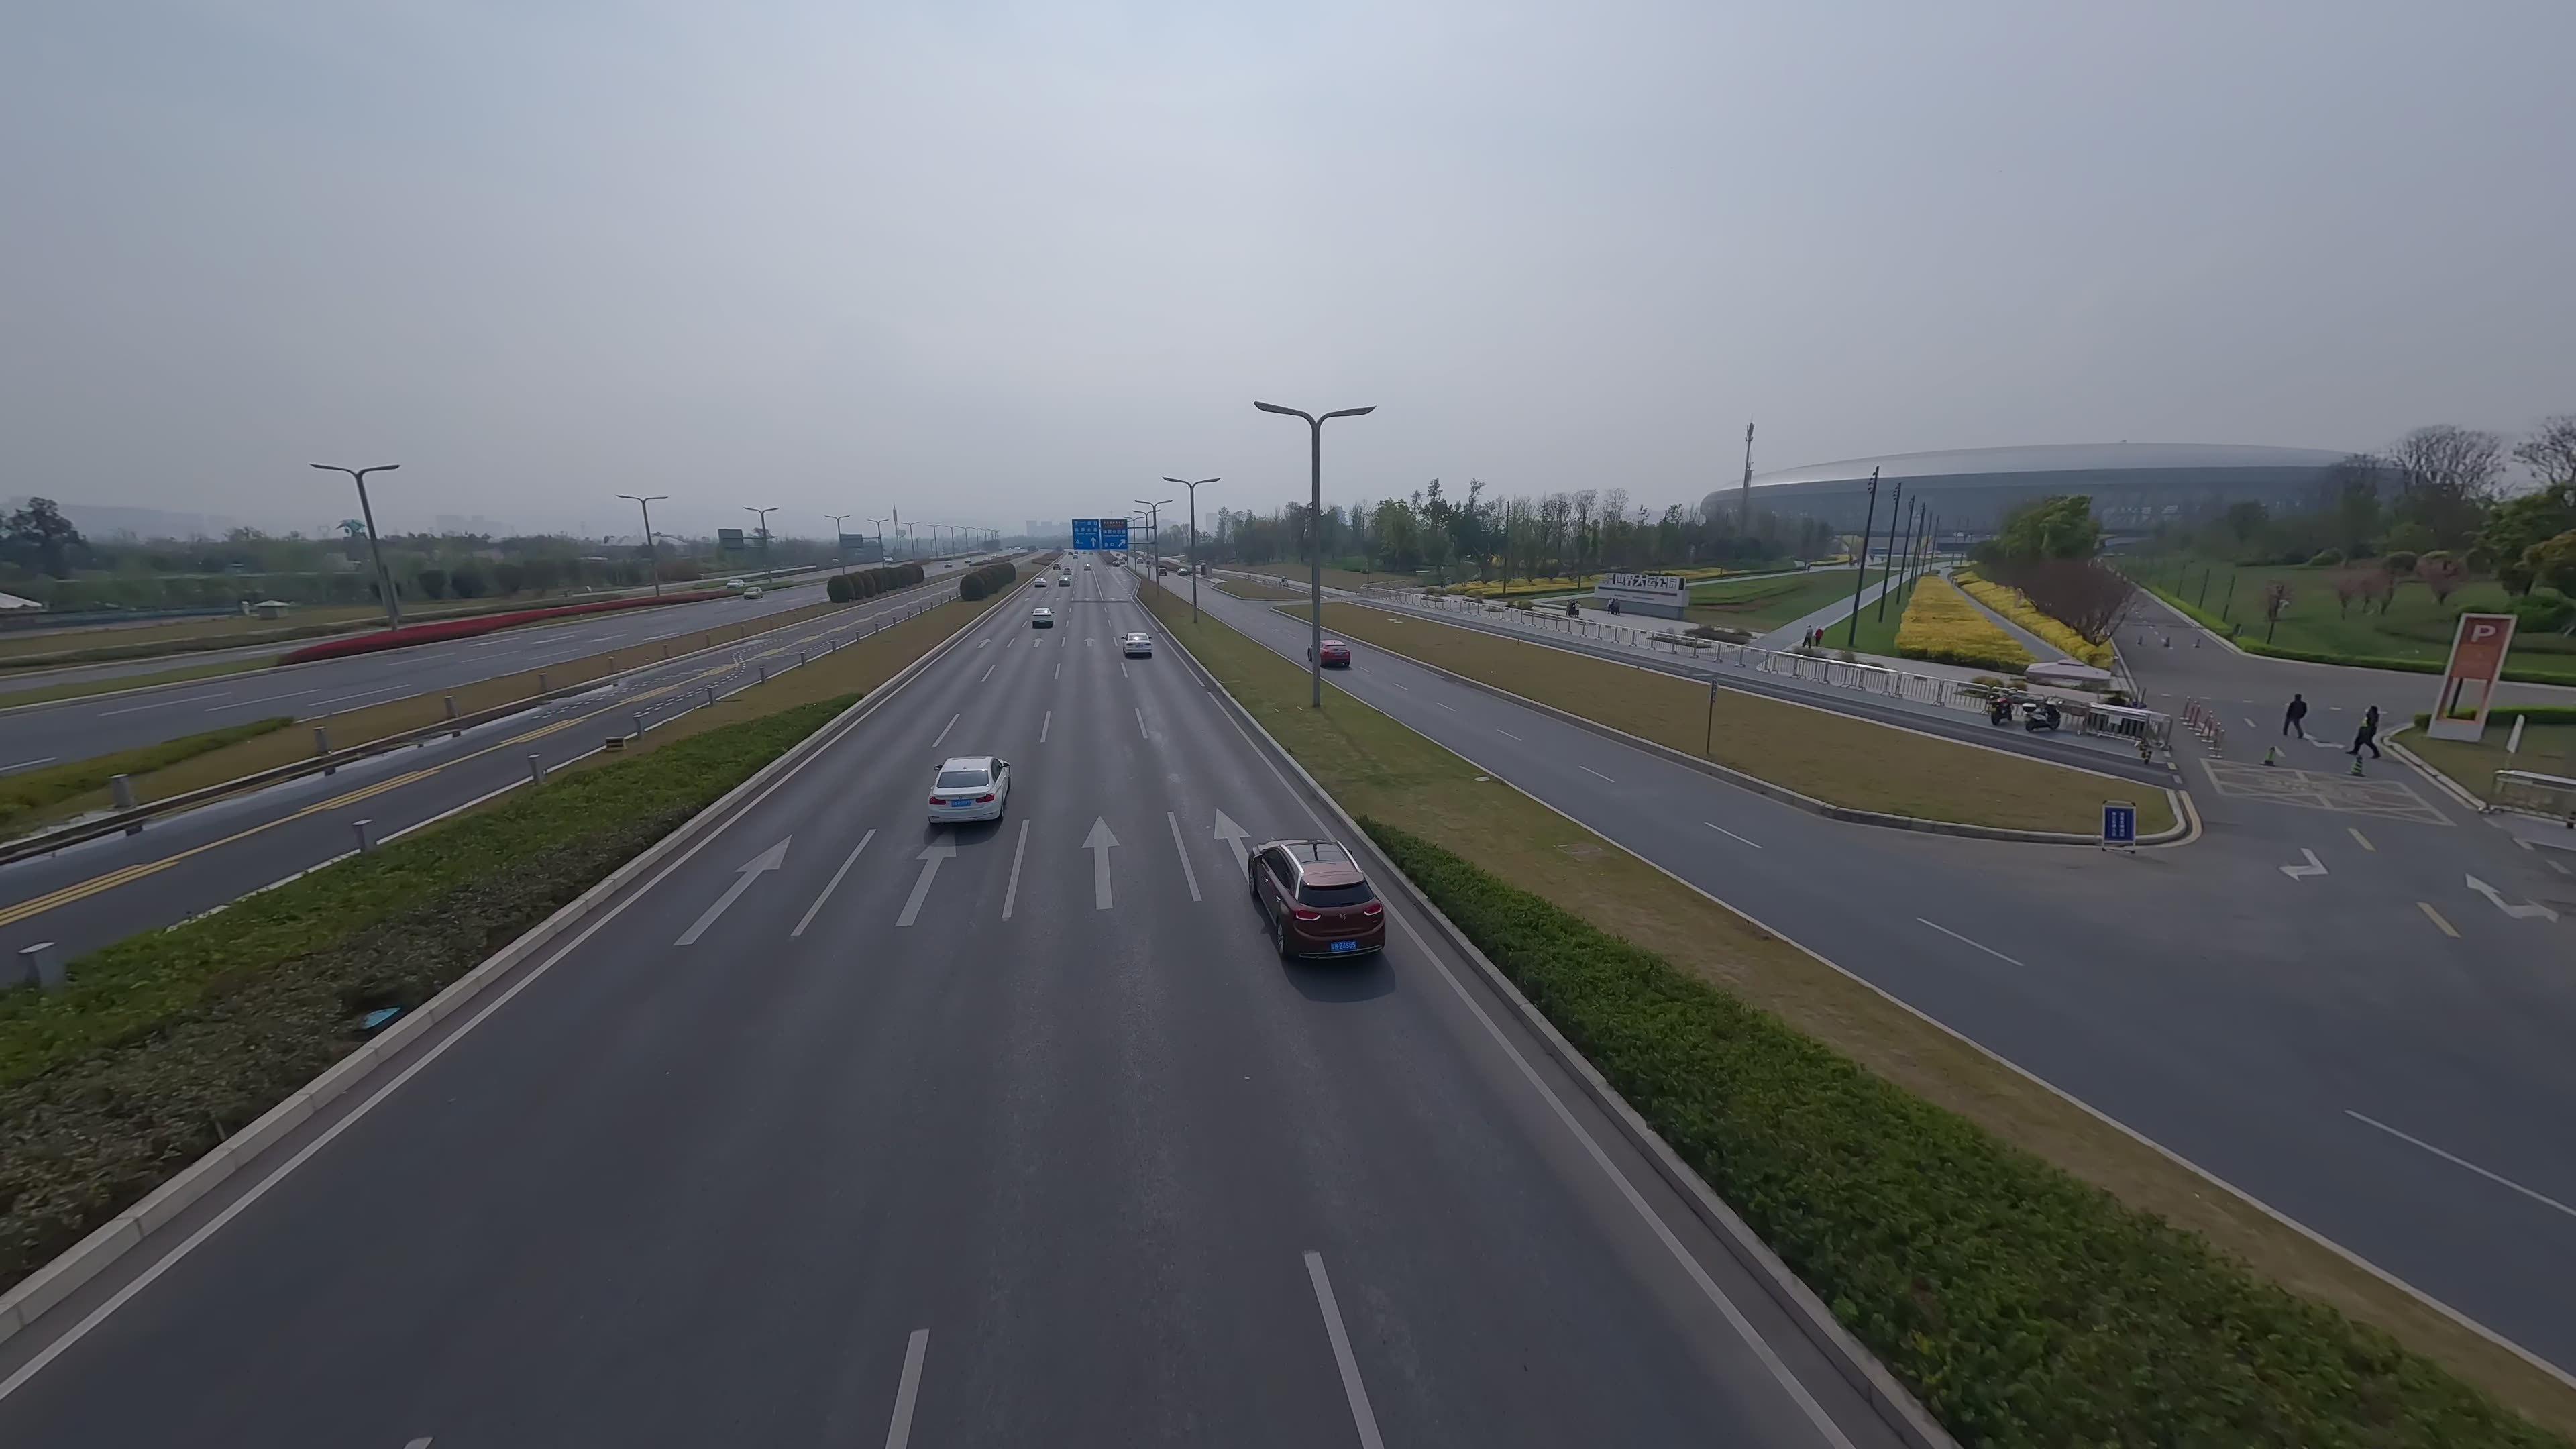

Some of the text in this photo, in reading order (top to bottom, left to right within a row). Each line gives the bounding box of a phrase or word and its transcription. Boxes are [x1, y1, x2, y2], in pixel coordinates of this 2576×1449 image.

[1615, 573, 1678, 590] 世界大运公园
[2471, 624, 2496, 642] P
